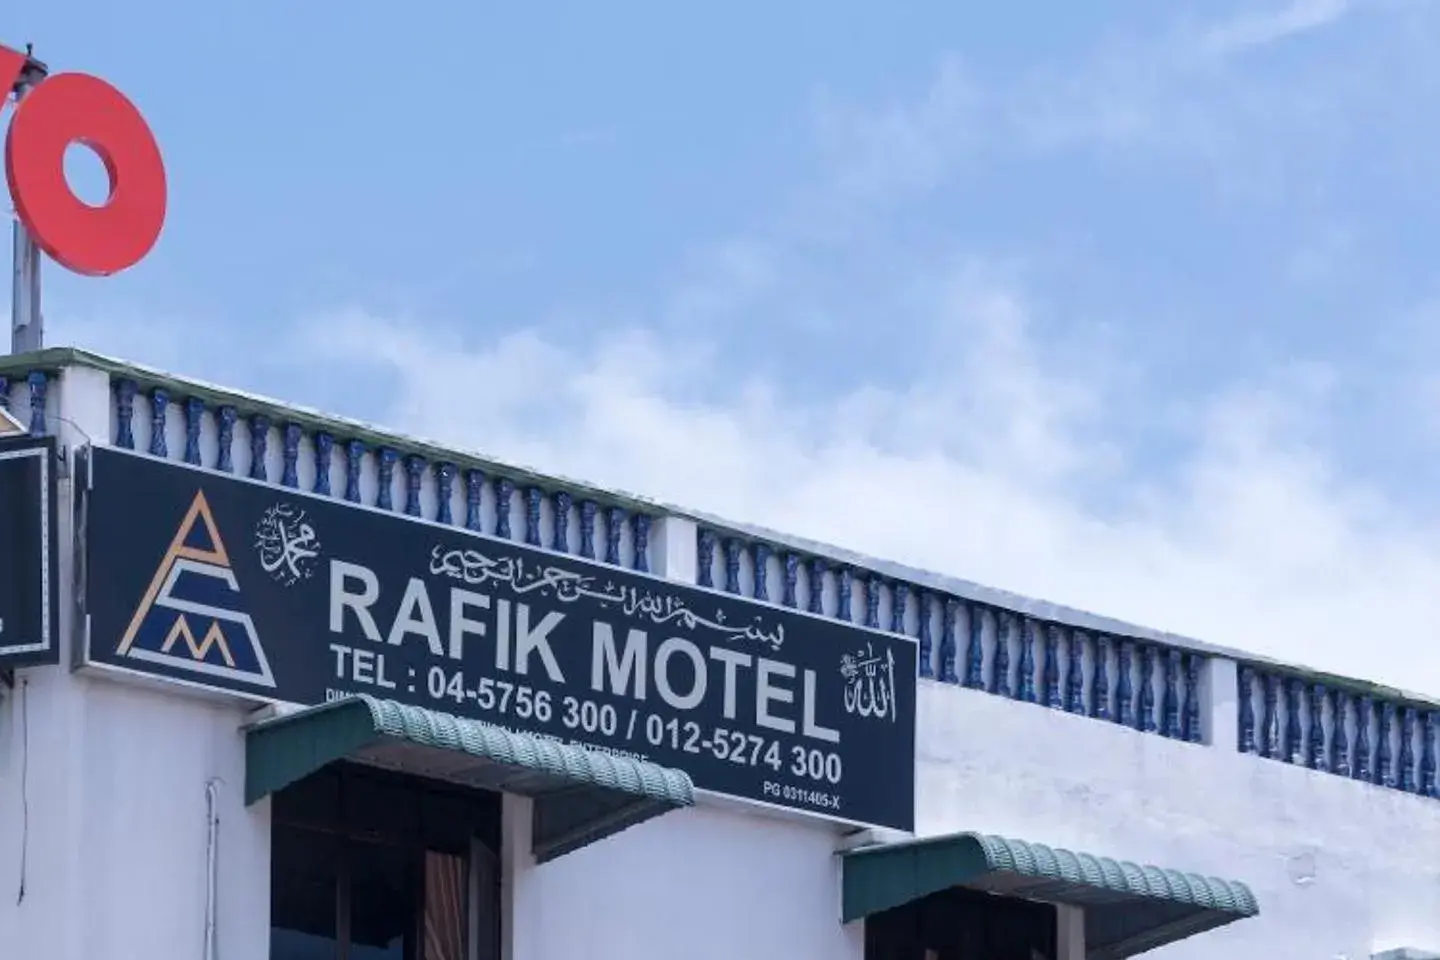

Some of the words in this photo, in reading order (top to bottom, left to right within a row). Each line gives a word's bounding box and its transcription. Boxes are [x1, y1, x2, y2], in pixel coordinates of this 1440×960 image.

[328, 559, 567, 684] RAFIK
[590, 621, 840, 744] MOTEL
[330, 643, 396, 690] TEL
[427, 665, 553, 723] 04-5756
[562, 696, 617, 737] 300
[626, 708, 638, 741] /
[646, 714, 782, 772] 012-5274
[791, 745, 842, 784] 300
[763, 780, 781, 797] PG
